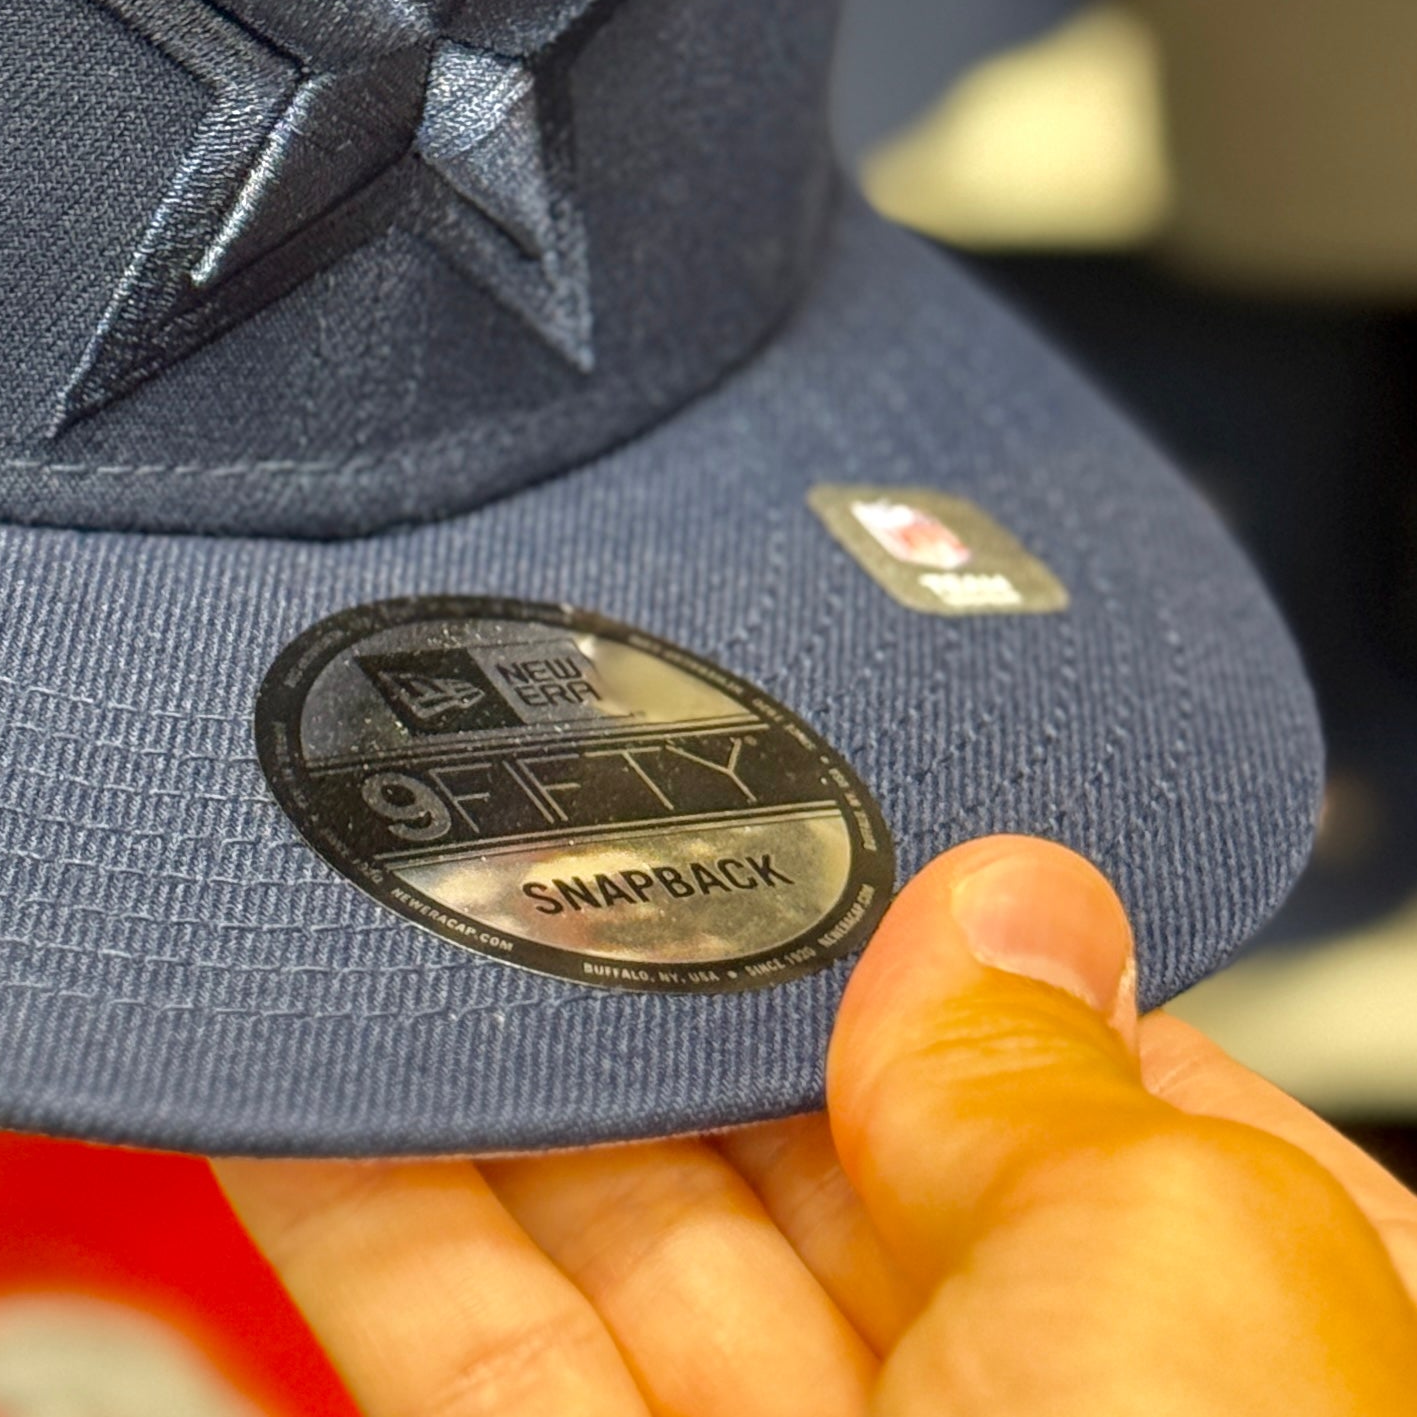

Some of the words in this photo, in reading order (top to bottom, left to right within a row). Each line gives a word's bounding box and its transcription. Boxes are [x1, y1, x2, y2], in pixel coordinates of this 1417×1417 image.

[496, 655, 580, 685] NEW
[514, 680, 602, 708] ERA
[361, 737, 757, 841] 9FIFTY
[522, 853, 796, 916] SNAPBACK
[390, 886, 514, 952] NEWERACAP.COM
[582, 961, 655, 984] BUFFALO,
[688, 969, 719, 983] USA
[744, 957, 786, 978] SINCE
